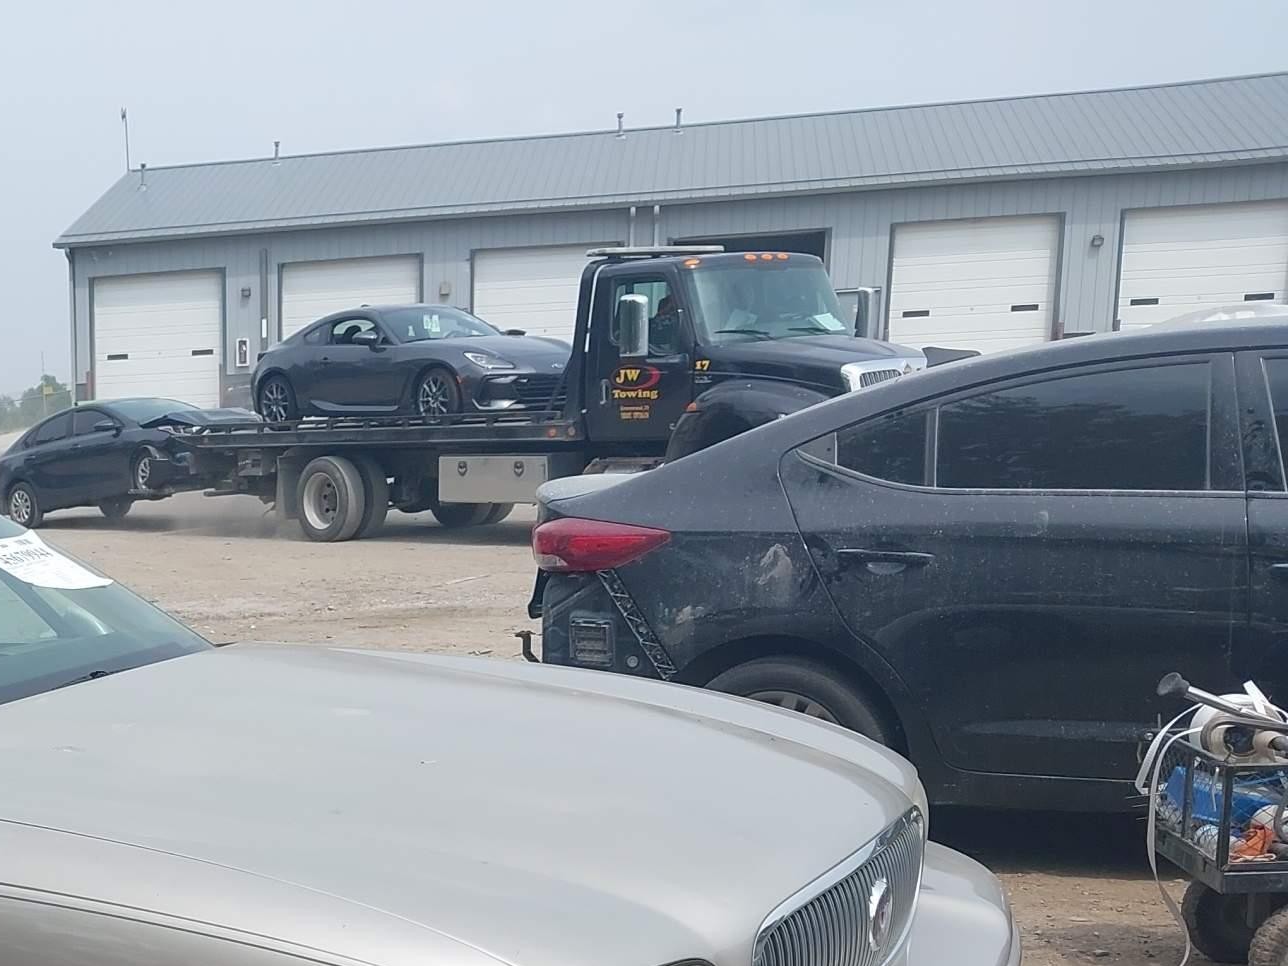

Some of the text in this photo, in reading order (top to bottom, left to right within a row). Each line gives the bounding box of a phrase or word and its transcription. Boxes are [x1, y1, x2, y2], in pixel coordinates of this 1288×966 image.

[695, 360, 711, 371] 17
[616, 369, 641, 384] JW
[612, 389, 659, 400] Towing
